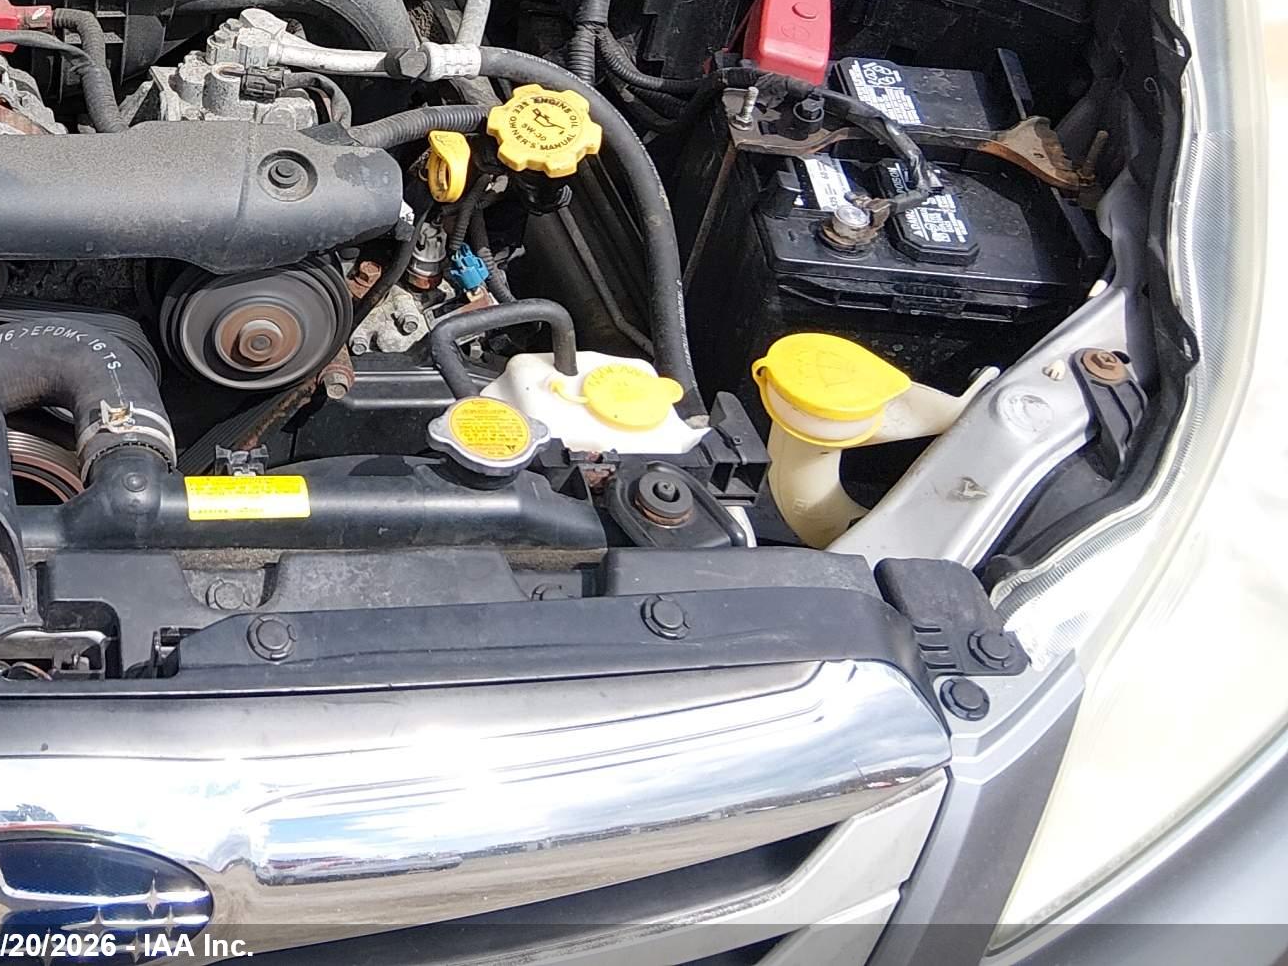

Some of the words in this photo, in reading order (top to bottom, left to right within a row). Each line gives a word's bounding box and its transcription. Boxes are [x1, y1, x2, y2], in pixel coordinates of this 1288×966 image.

[513, 101, 530, 114] SEE
[533, 97, 572, 114] ENGINE
[569, 115, 579, 128] OIL
[509, 116, 536, 149] OWNER'S
[539, 133, 577, 151] MANUAL
